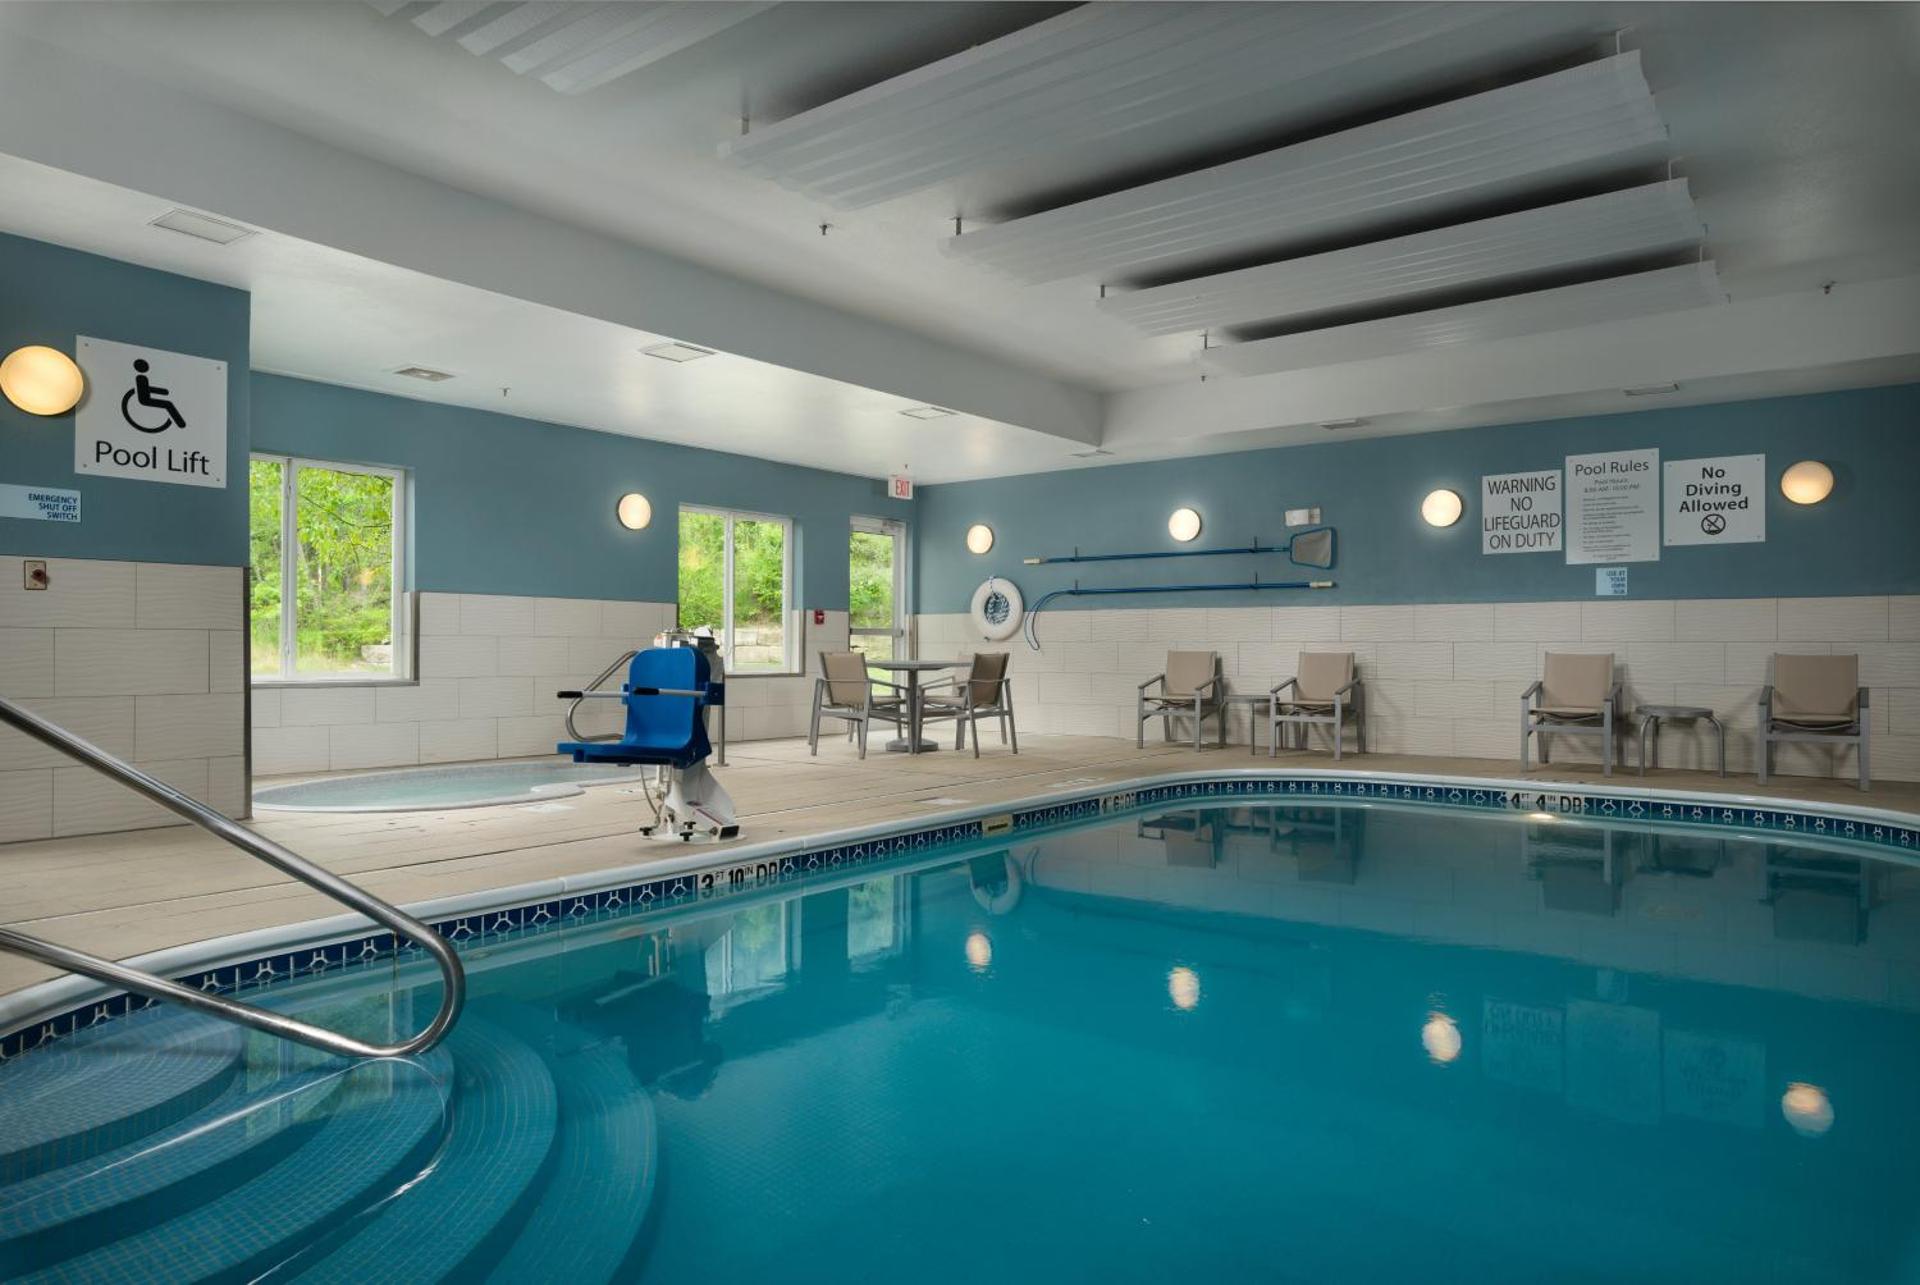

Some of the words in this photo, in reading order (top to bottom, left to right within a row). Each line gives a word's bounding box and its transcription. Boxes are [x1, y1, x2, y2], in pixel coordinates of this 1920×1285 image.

[96, 440, 156, 469] Pool
[168, 449, 210, 475] Lift
[1575, 462, 1606, 476] Pool
[1610, 460, 1649, 473] Rules
[1702, 466, 1725, 479] No
[896, 479, 910, 497] EXIT
[1488, 475, 1556, 495] WARNING
[1686, 482, 1741, 497] Diving
[28, 493, 77, 504] EMERGENCY
[1511, 496, 1532, 512] NO
[1679, 496, 1749, 513] Allowed
[39, 502, 60, 511] SHUT
[62, 504, 77, 512] OFF
[47, 511, 77, 520] SWITCH
[1484, 512, 1560, 532] LIFEGUARD
[1489, 534, 1511, 549] ON
[1515, 531, 1555, 548] DUTY
[728, 868, 745, 885] 10
